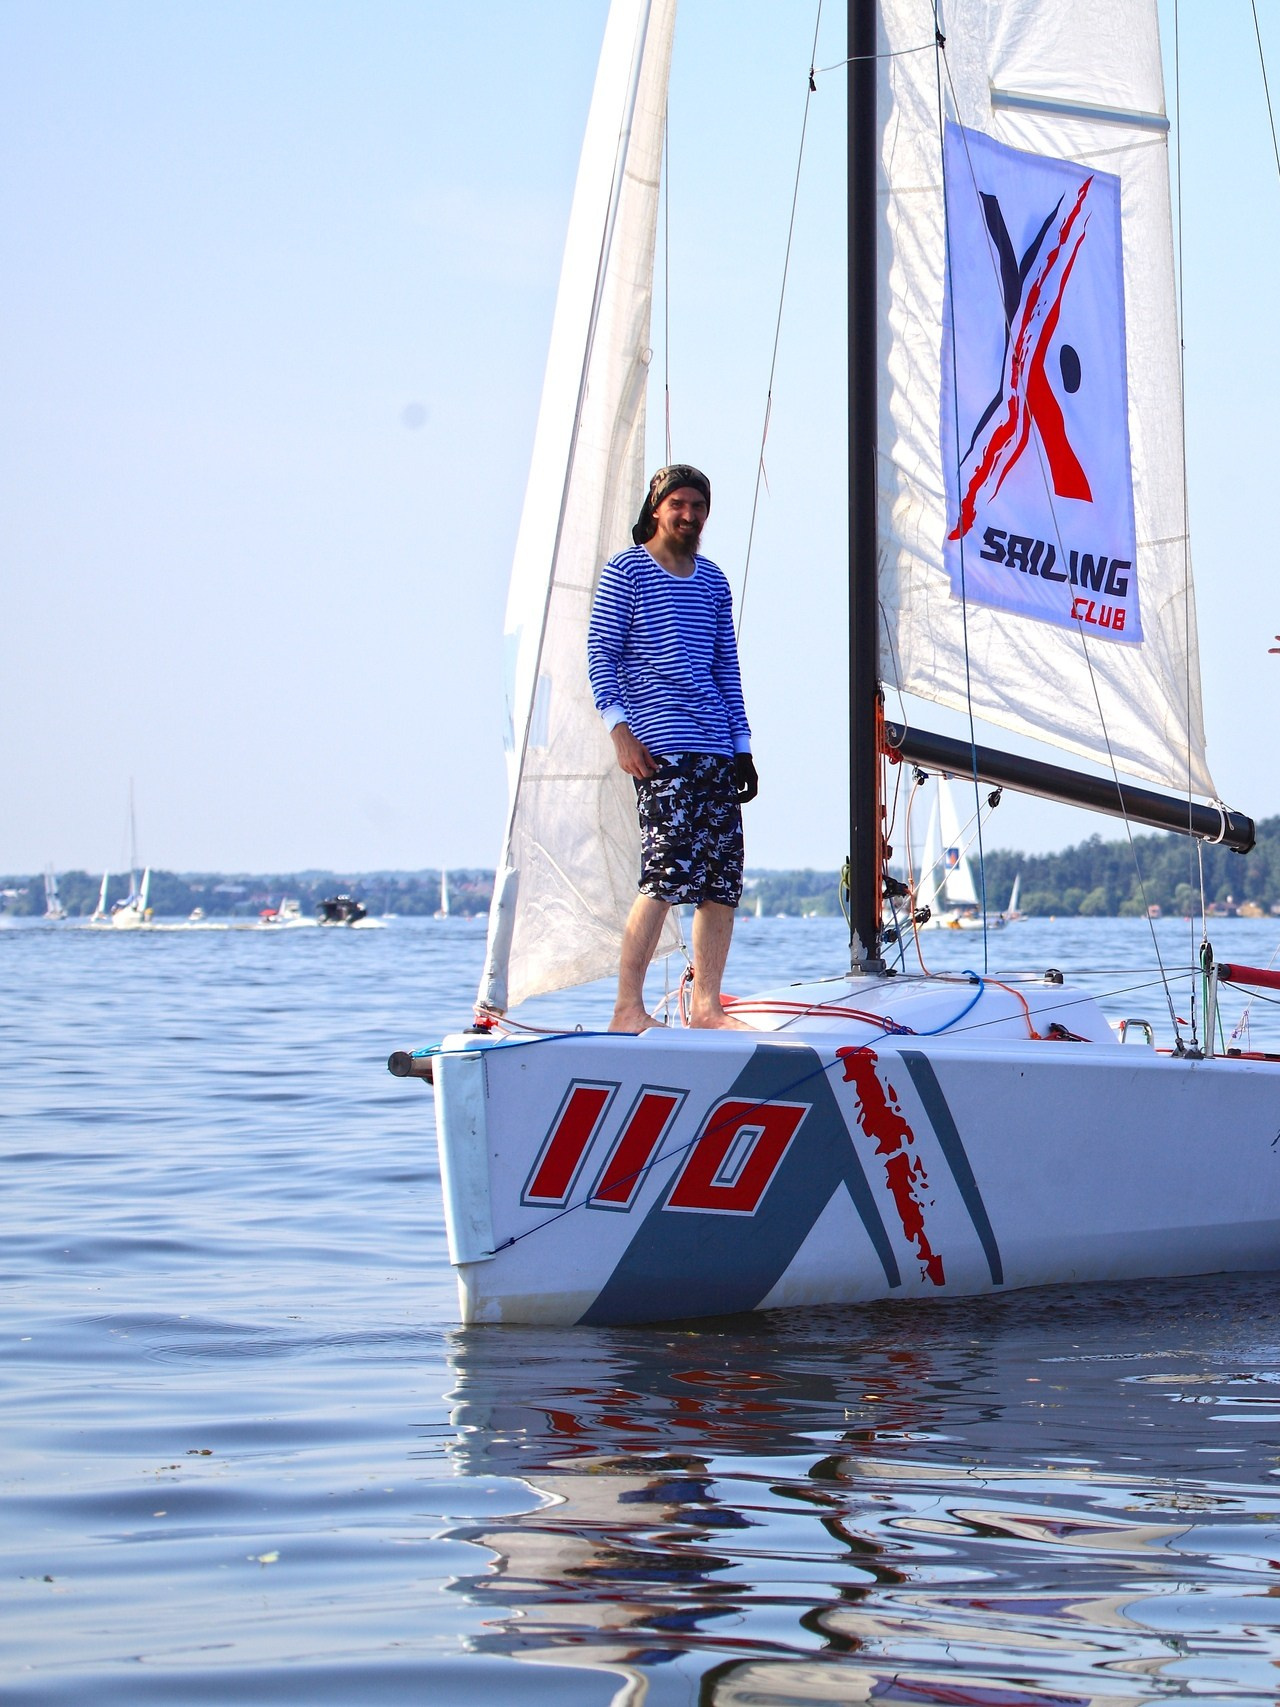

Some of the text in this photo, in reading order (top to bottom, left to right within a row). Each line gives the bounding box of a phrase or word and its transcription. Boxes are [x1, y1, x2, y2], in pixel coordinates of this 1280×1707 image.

[980, 527, 1132, 597] SAILING
[1071, 598, 1126, 631] CLUB
[520, 1078, 813, 1217] 110
